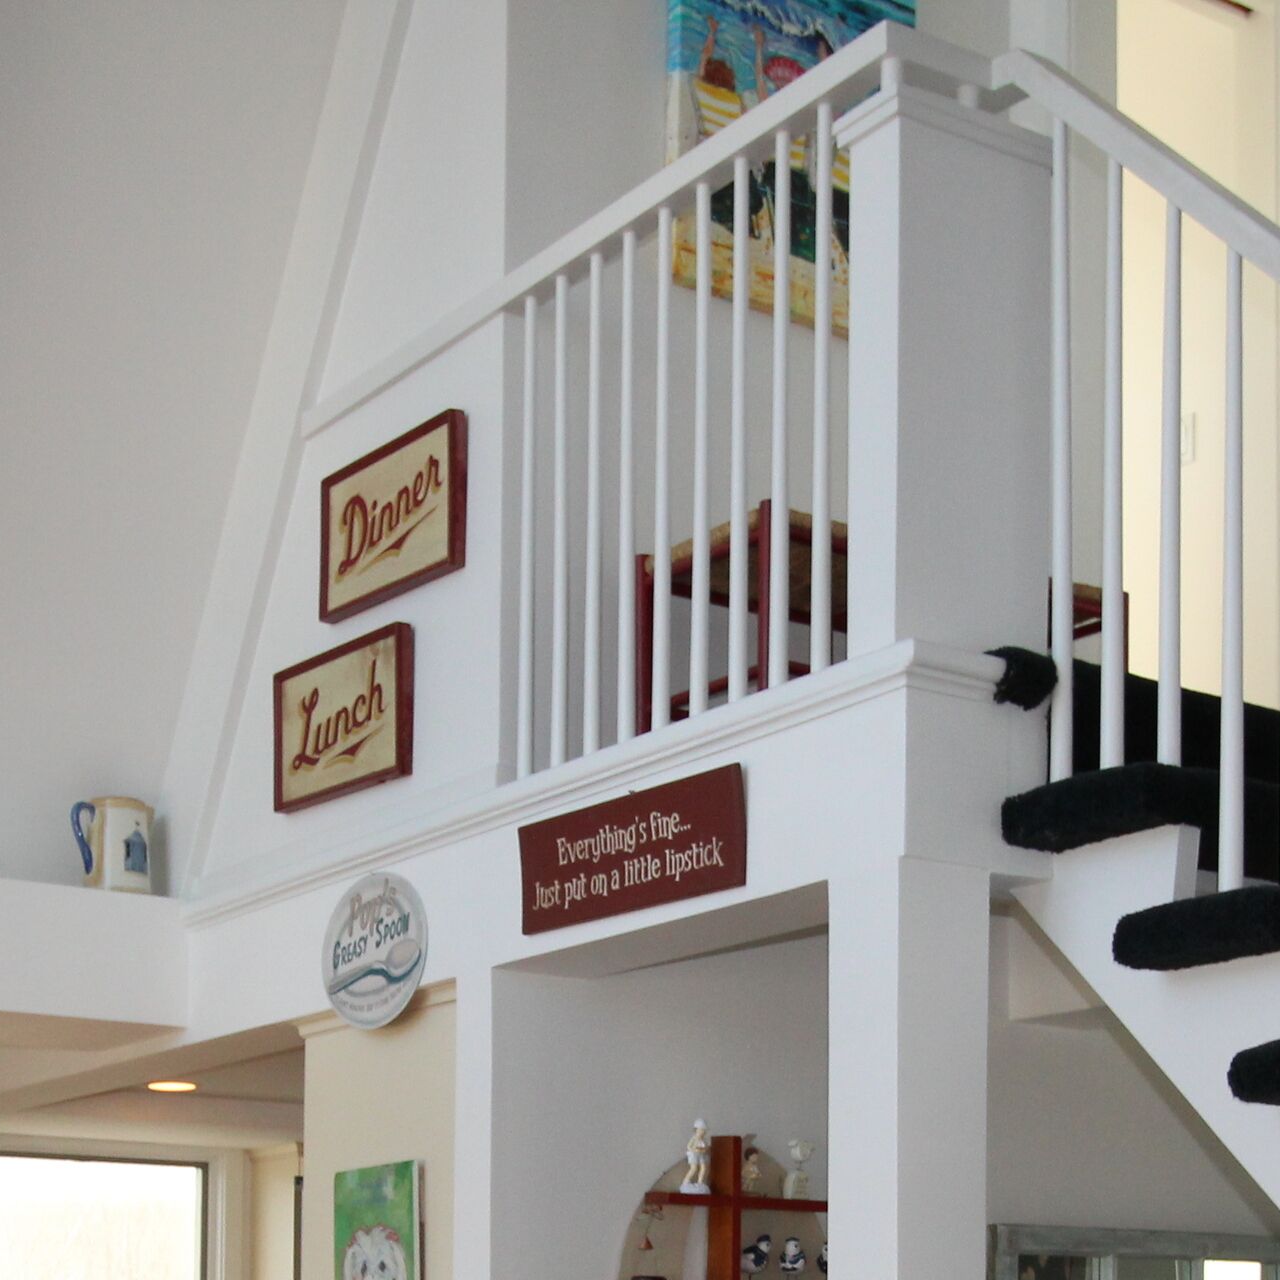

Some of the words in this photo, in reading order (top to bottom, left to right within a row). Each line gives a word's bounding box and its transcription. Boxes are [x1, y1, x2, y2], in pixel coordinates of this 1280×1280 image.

[337, 454, 443, 577] Dinner
[291, 658, 385, 771] Lunch
[532, 880, 562, 911] Just
[564, 873, 586, 909] put
[590, 873, 608, 897] on
[611, 868, 620, 891] a
[623, 854, 662, 887] little
[664, 836, 725, 882] lipstick
[556, 816, 648, 866] Everything's
[649, 811, 692, 842] fine...
[332, 934, 368, 970] GREASY
[375, 911, 410, 948] SPOON
